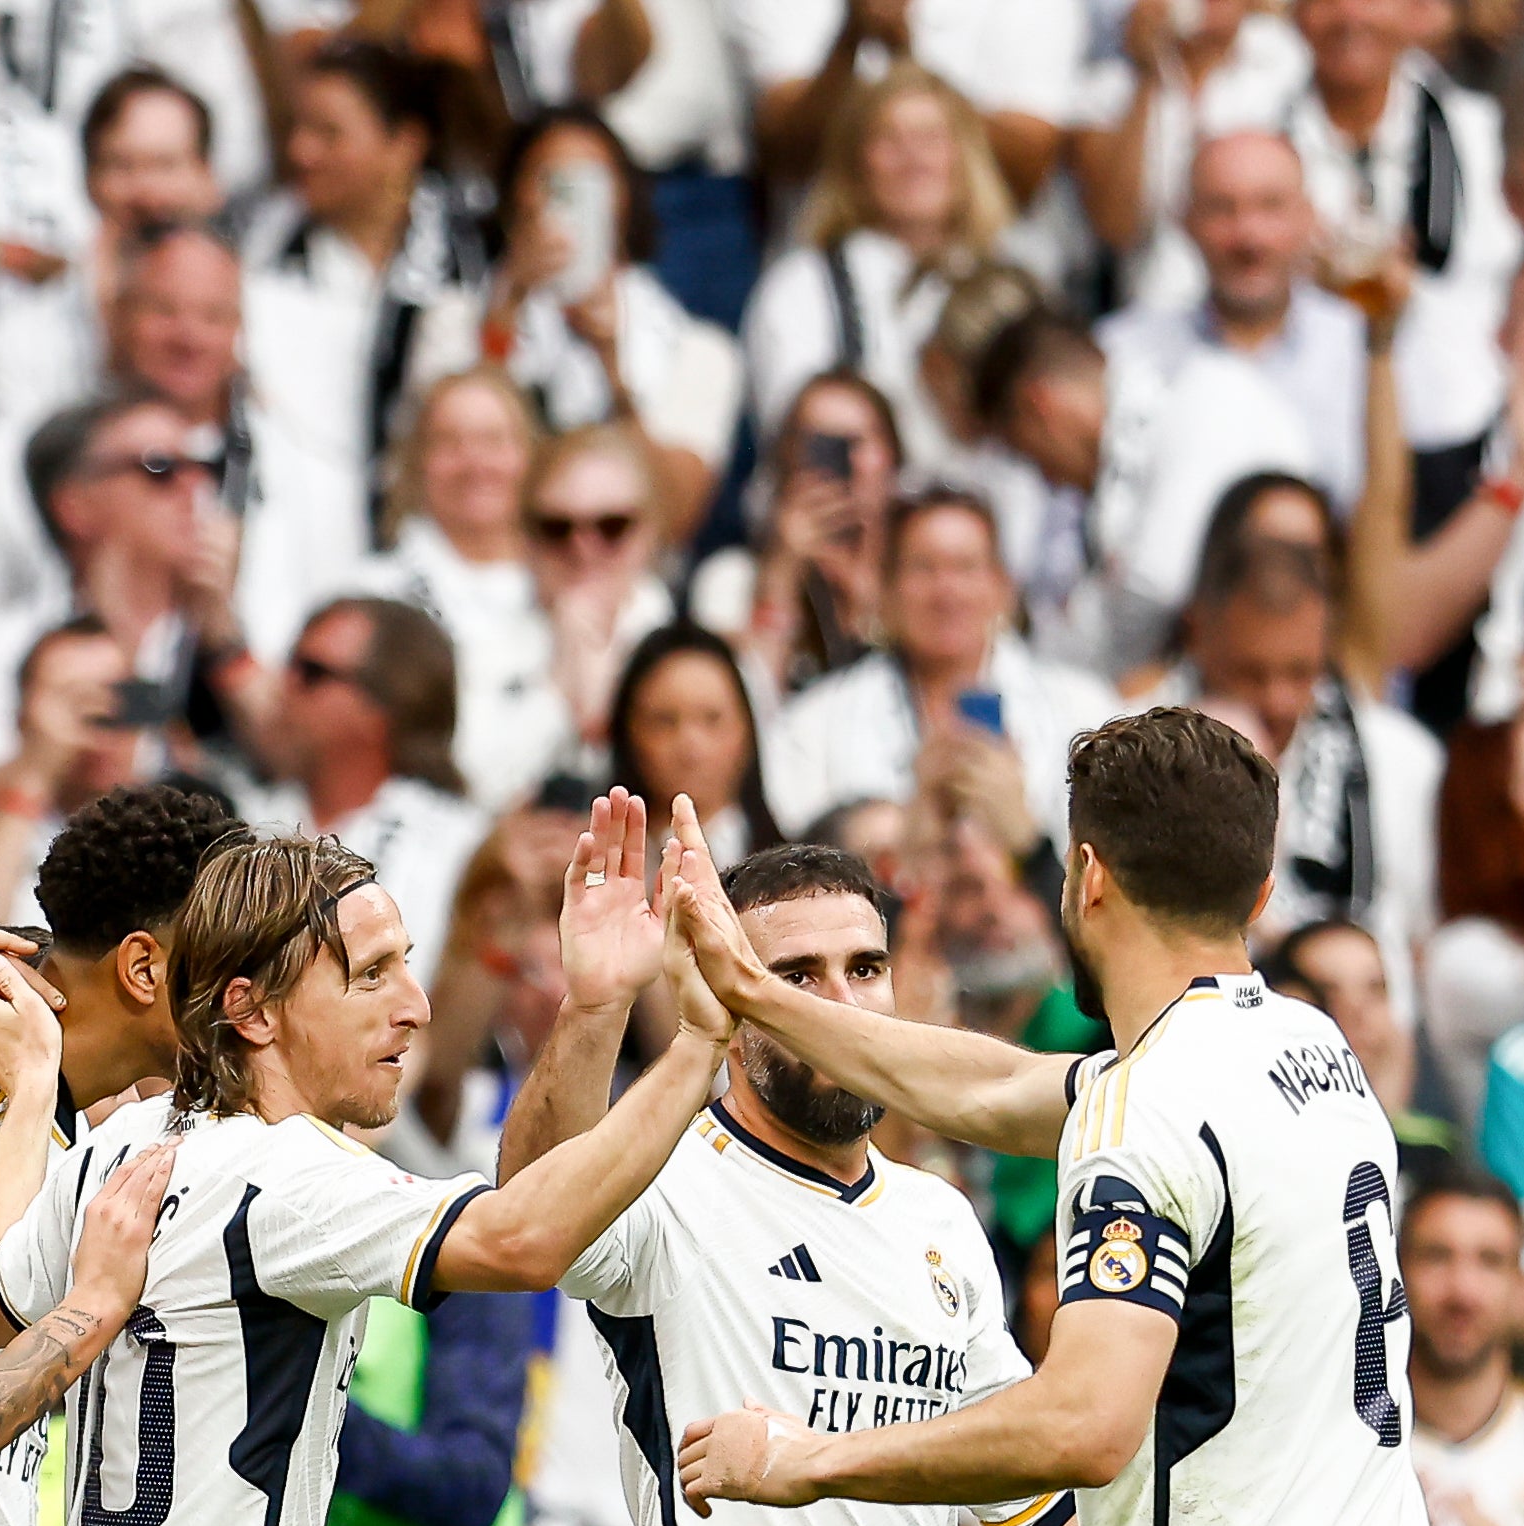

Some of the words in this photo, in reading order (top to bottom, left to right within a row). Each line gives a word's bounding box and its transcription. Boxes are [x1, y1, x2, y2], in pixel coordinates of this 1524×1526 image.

[1267, 1044, 1365, 1116] NACHO
[1342, 1161, 1409, 1446] 6
[771, 1315, 969, 1395] Emirates
[807, 1388, 863, 1433] FLY
[873, 1394, 949, 1430] BETTE
